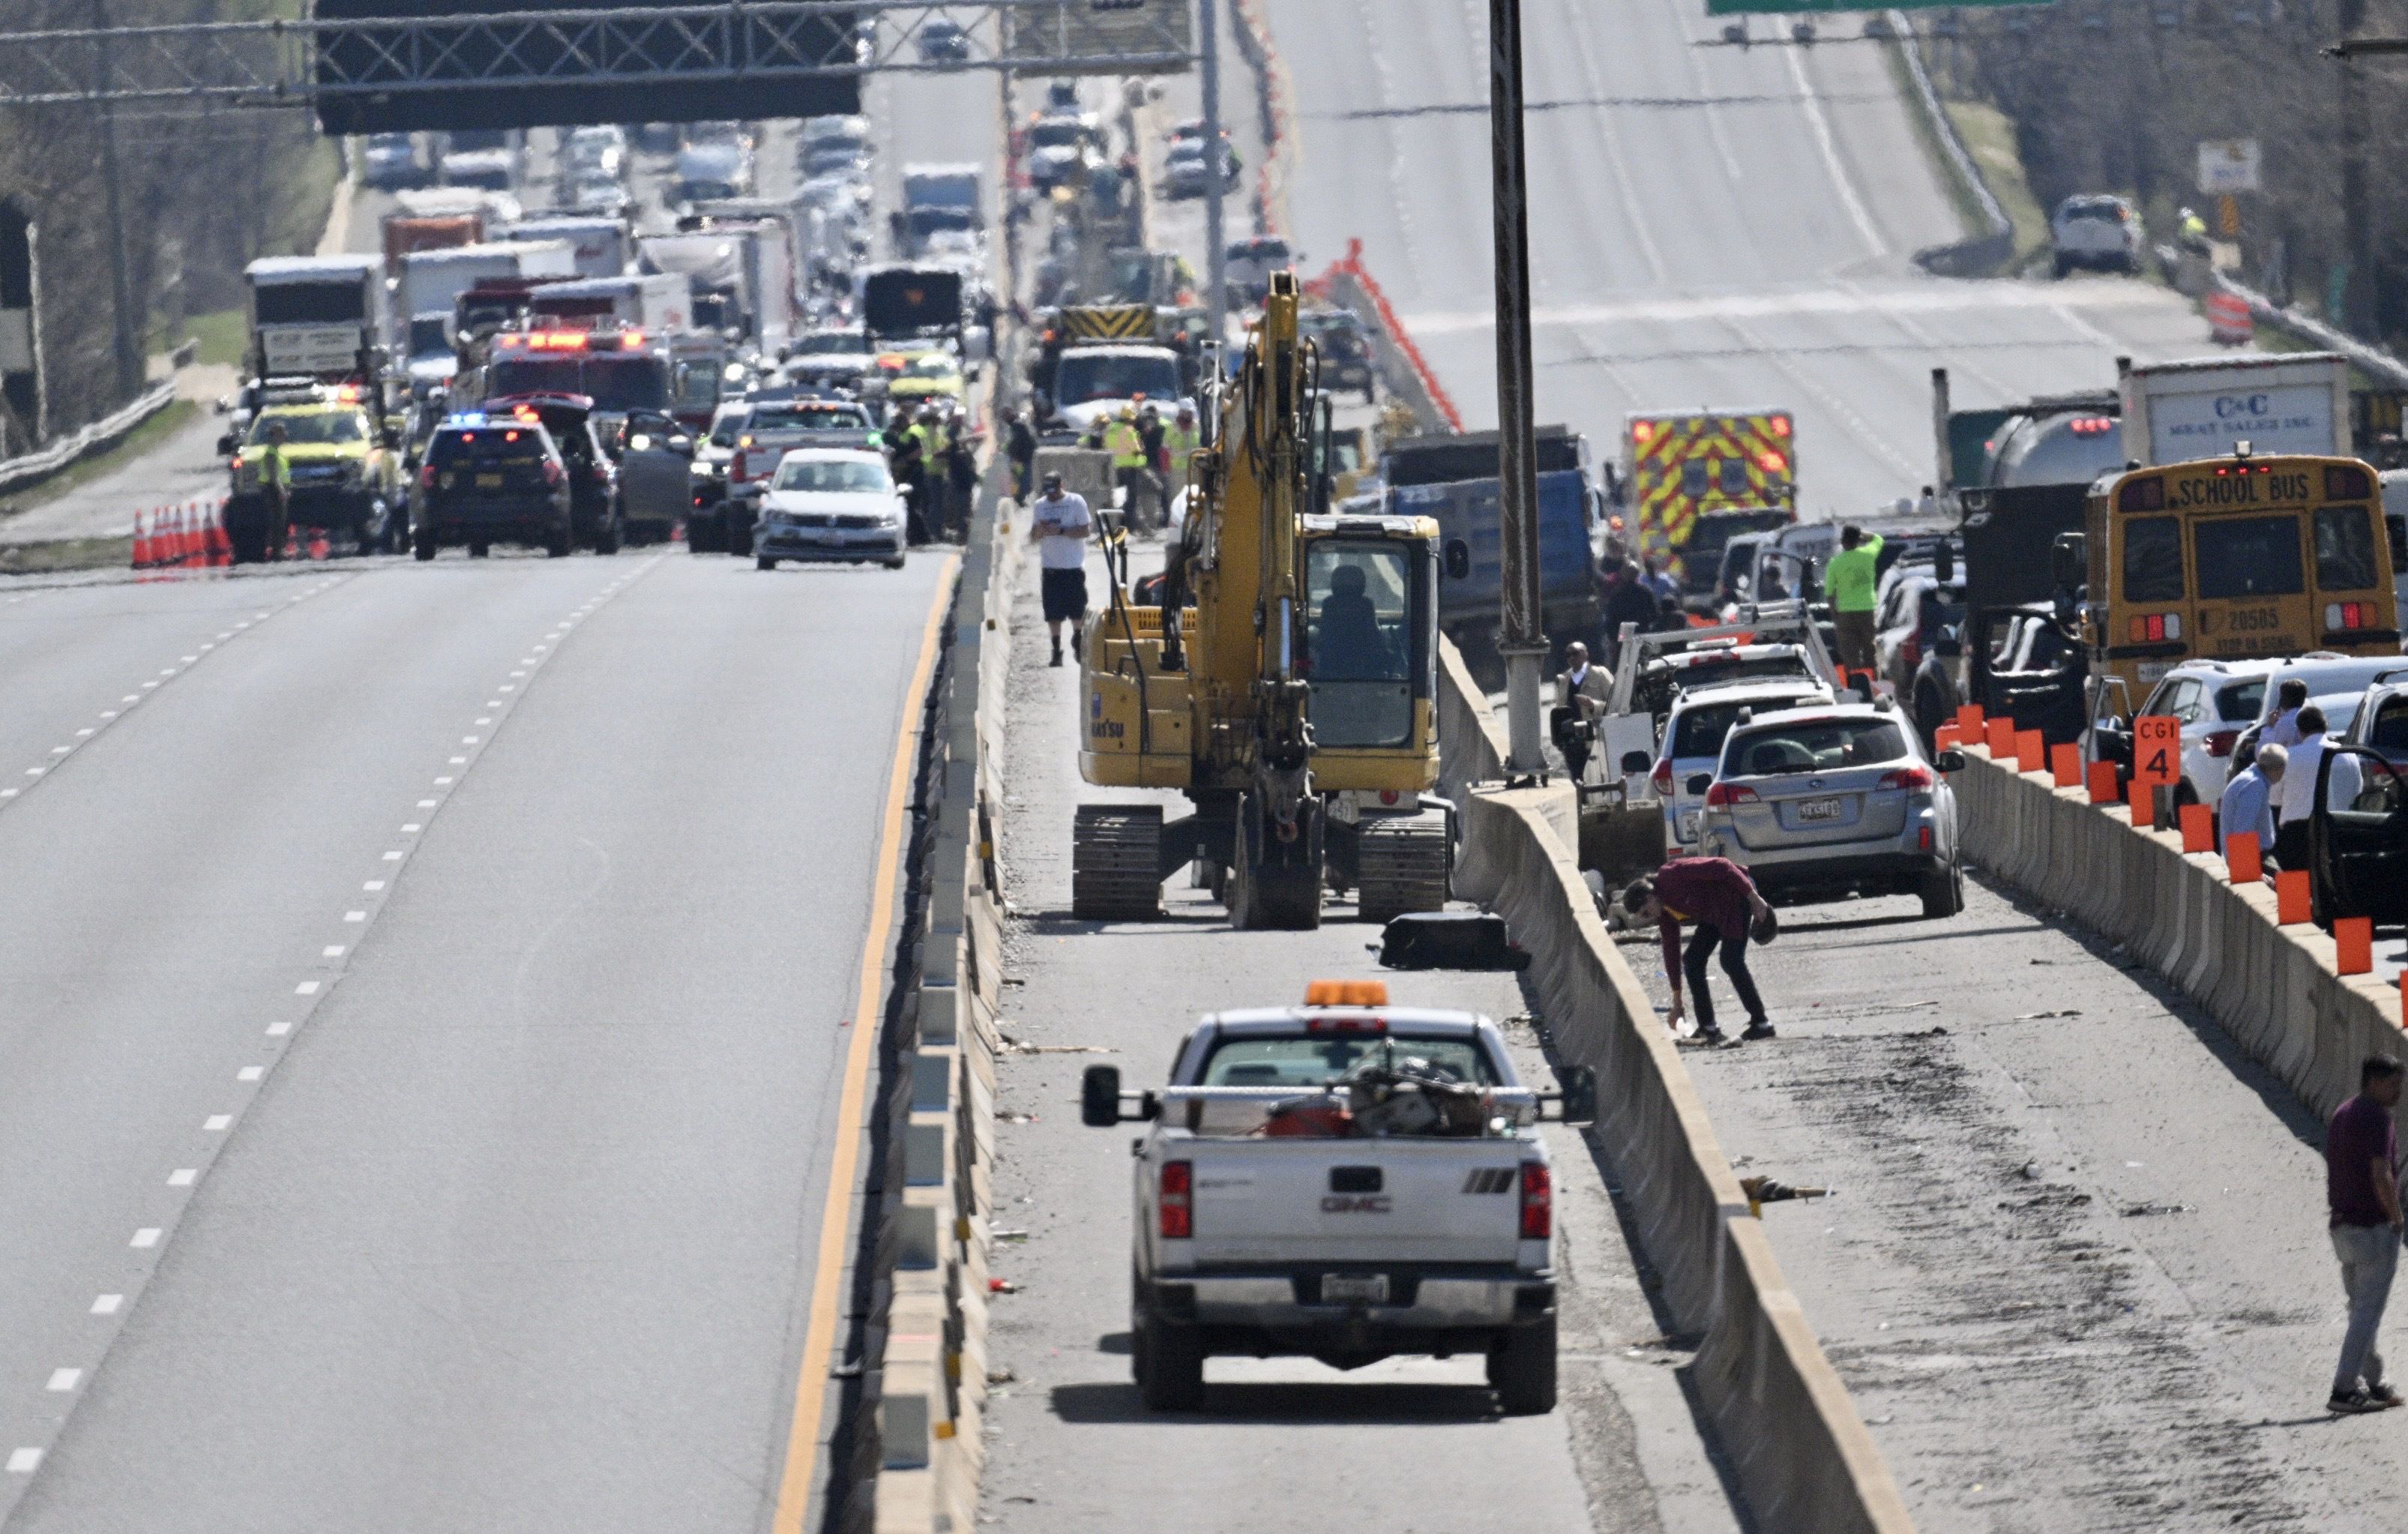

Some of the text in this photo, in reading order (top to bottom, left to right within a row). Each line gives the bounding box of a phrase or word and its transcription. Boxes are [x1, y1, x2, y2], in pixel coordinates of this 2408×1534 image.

[2179, 472, 2309, 505] SCHOOL BUS
[2140, 721, 2175, 739] CGI
[2145, 748, 2169, 778] 4
[1320, 1196, 1392, 1213] GMC
